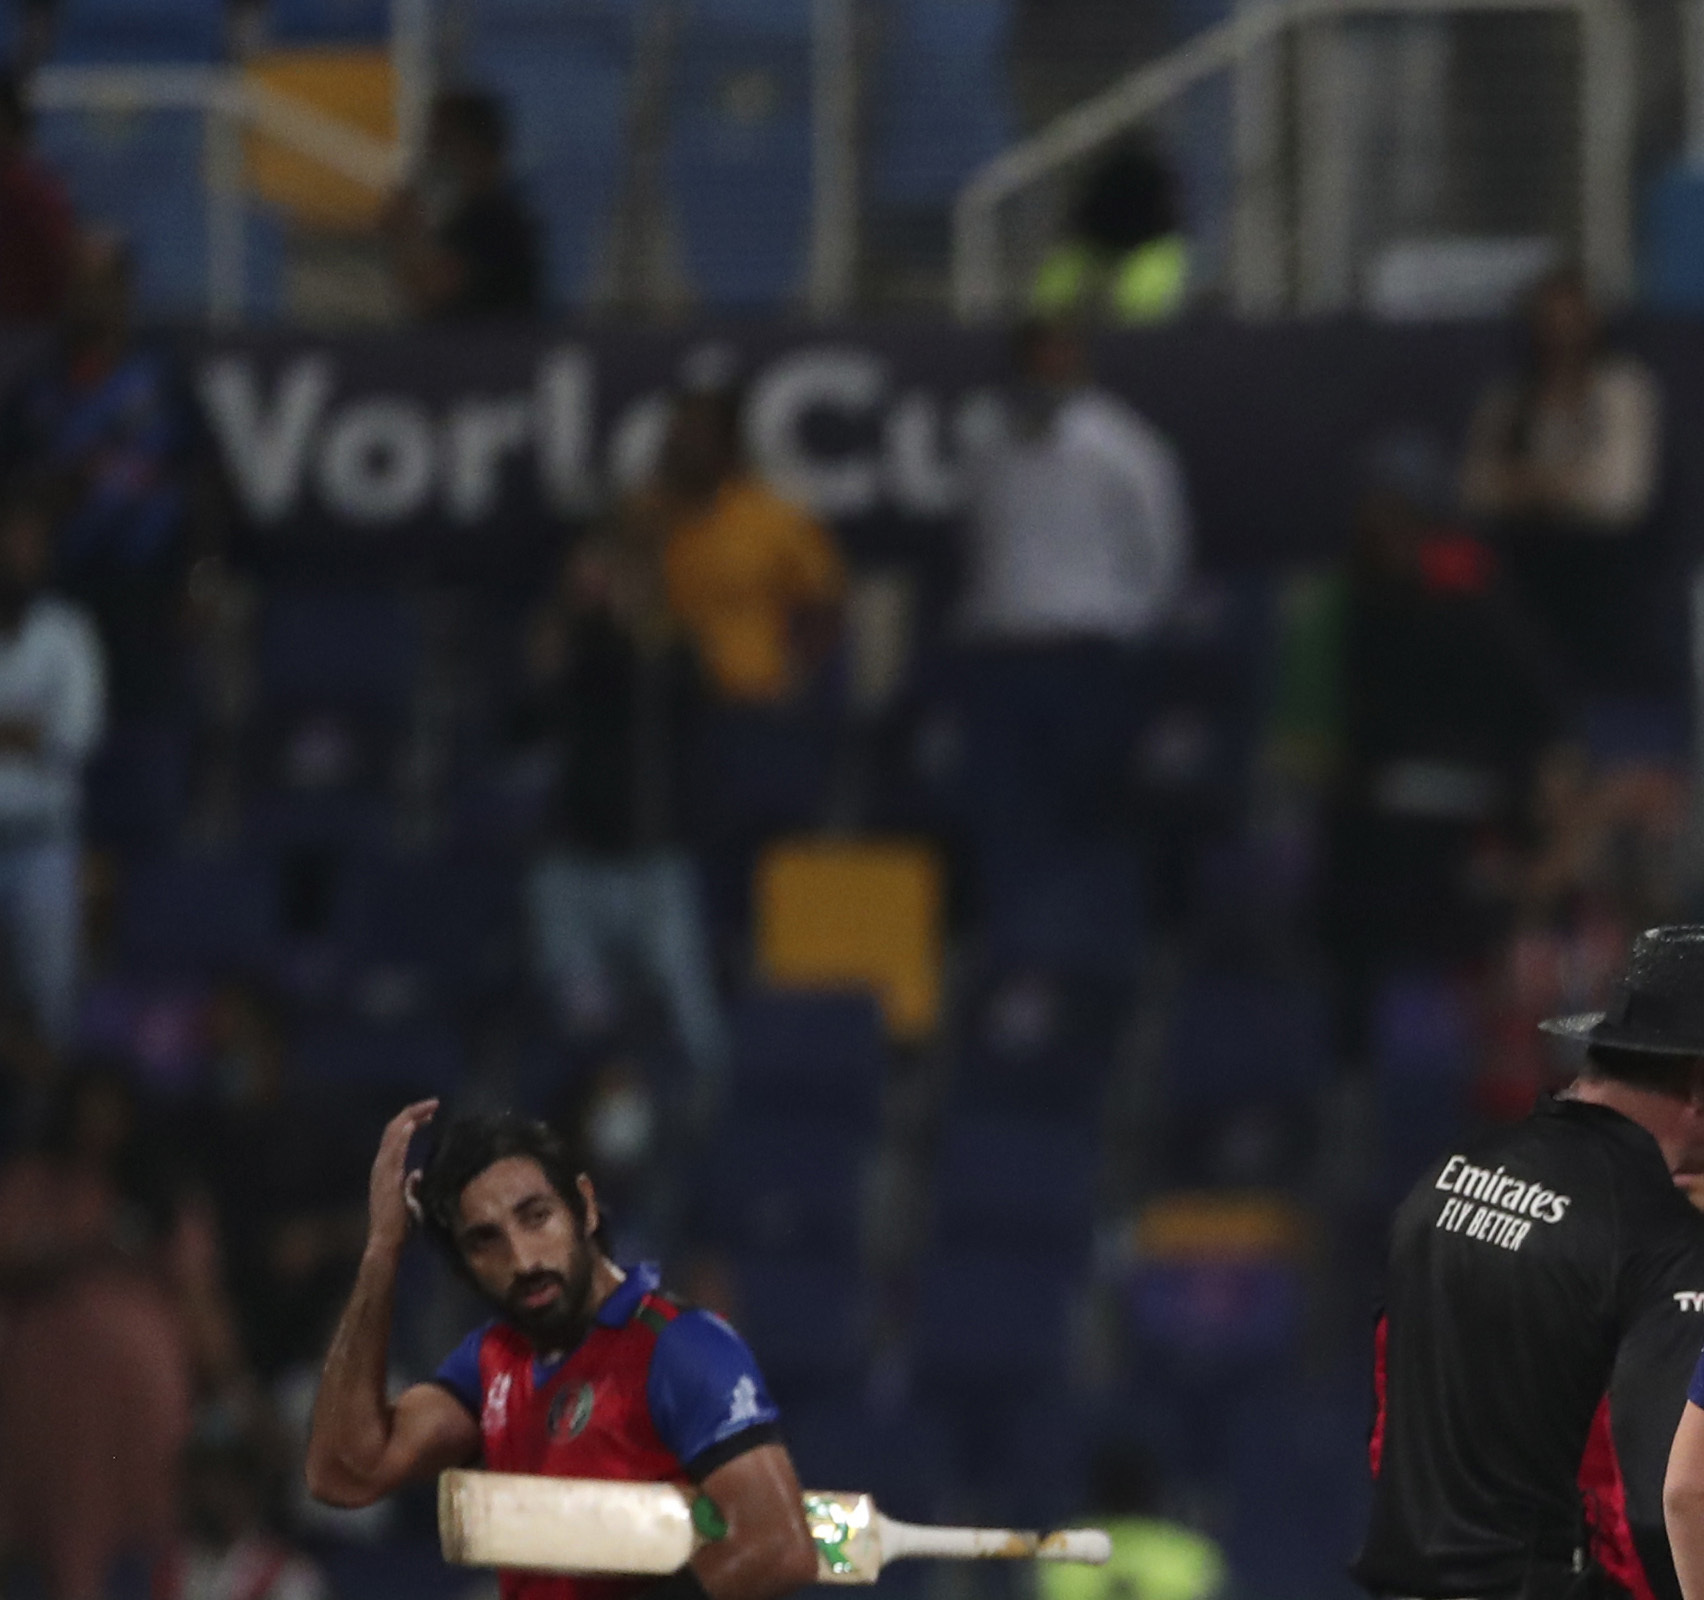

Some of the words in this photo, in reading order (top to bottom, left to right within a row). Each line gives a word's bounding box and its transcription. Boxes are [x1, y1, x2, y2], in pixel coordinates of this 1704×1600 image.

[1434, 1153, 1572, 1224] Emirates
[1436, 1197, 1475, 1232] FLY
[1465, 1205, 1532, 1252] BETTER
